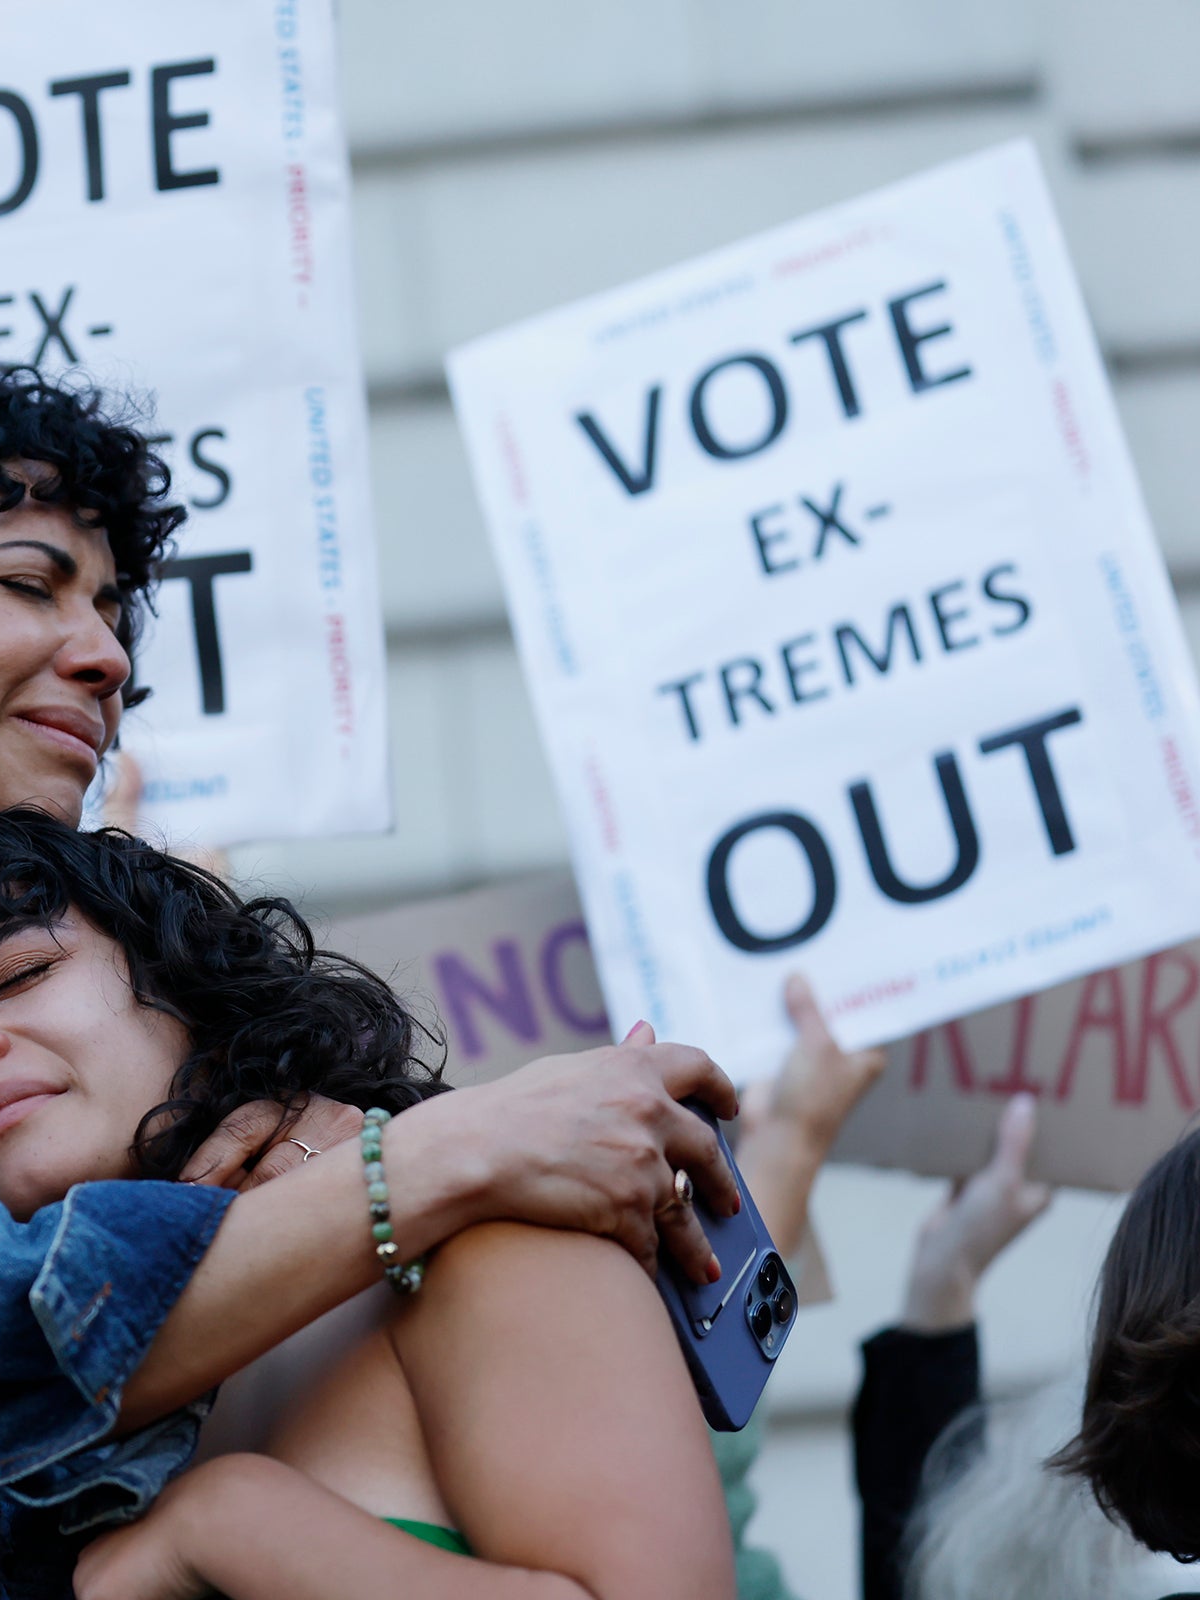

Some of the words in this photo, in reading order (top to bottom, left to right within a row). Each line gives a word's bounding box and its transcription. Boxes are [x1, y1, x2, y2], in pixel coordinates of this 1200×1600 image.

[575, 281, 972, 497] VOTE
[747, 483, 895, 577] EX-
[659, 562, 1034, 745] TREMES
[703, 706, 1085, 957] OUT
